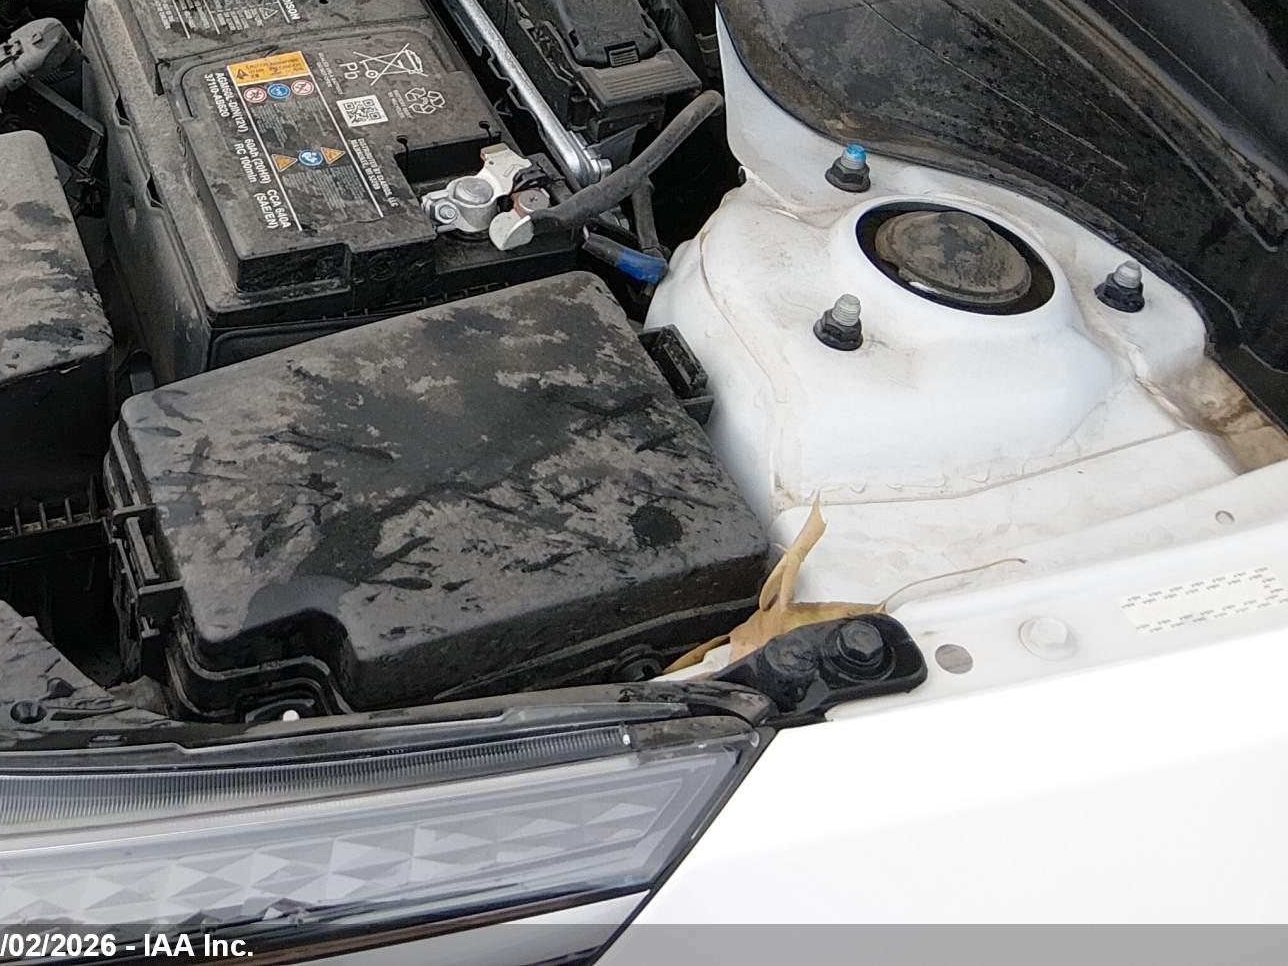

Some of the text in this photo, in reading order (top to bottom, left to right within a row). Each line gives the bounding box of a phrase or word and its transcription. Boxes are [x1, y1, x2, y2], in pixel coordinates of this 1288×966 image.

[339, 61, 359, 80] Pb
[233, 143, 247, 155] RC
[244, 138, 260, 160] 60Ah
[239, 156, 258, 183] 100min
[251, 158, 272, 184] (20HR)
[267, 189, 282, 208] CCA
[253, 192, 280, 229] (SAE/EN)
[275, 207, 292, 228] 640A
